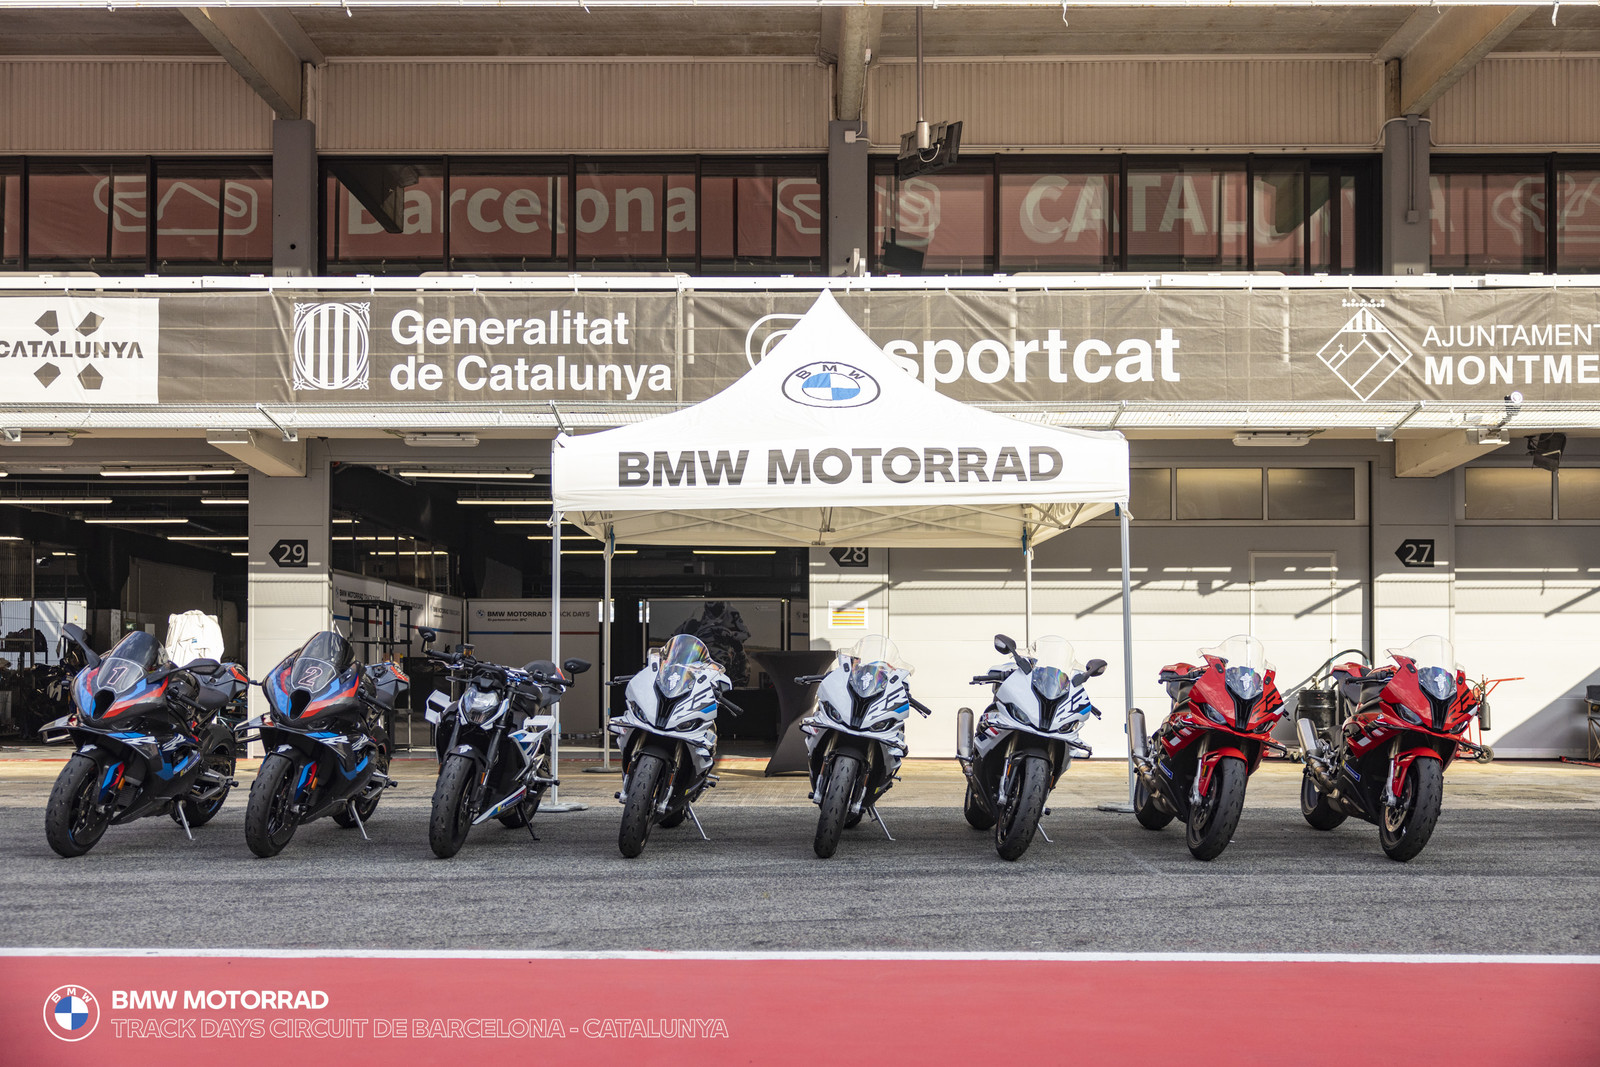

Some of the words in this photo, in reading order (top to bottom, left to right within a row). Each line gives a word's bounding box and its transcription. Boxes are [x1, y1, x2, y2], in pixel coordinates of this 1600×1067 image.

[391, 309, 629, 346] Generalitat
[1422, 324, 1600, 348] AJUNTAMEN
[390, 355, 443, 392] de
[457, 355, 672, 401] Catalunya
[795, 363, 865, 381] BMW
[1425, 354, 1600, 386] MONTME
[617, 449, 750, 488] BMW
[767, 445, 1064, 485] MOTORRAD
[279, 544, 305, 563] 29
[840, 547, 866, 563] 28
[1405, 544, 1431, 563] 27
[107, 666, 129, 685] 1
[298, 666, 324, 688] 2
